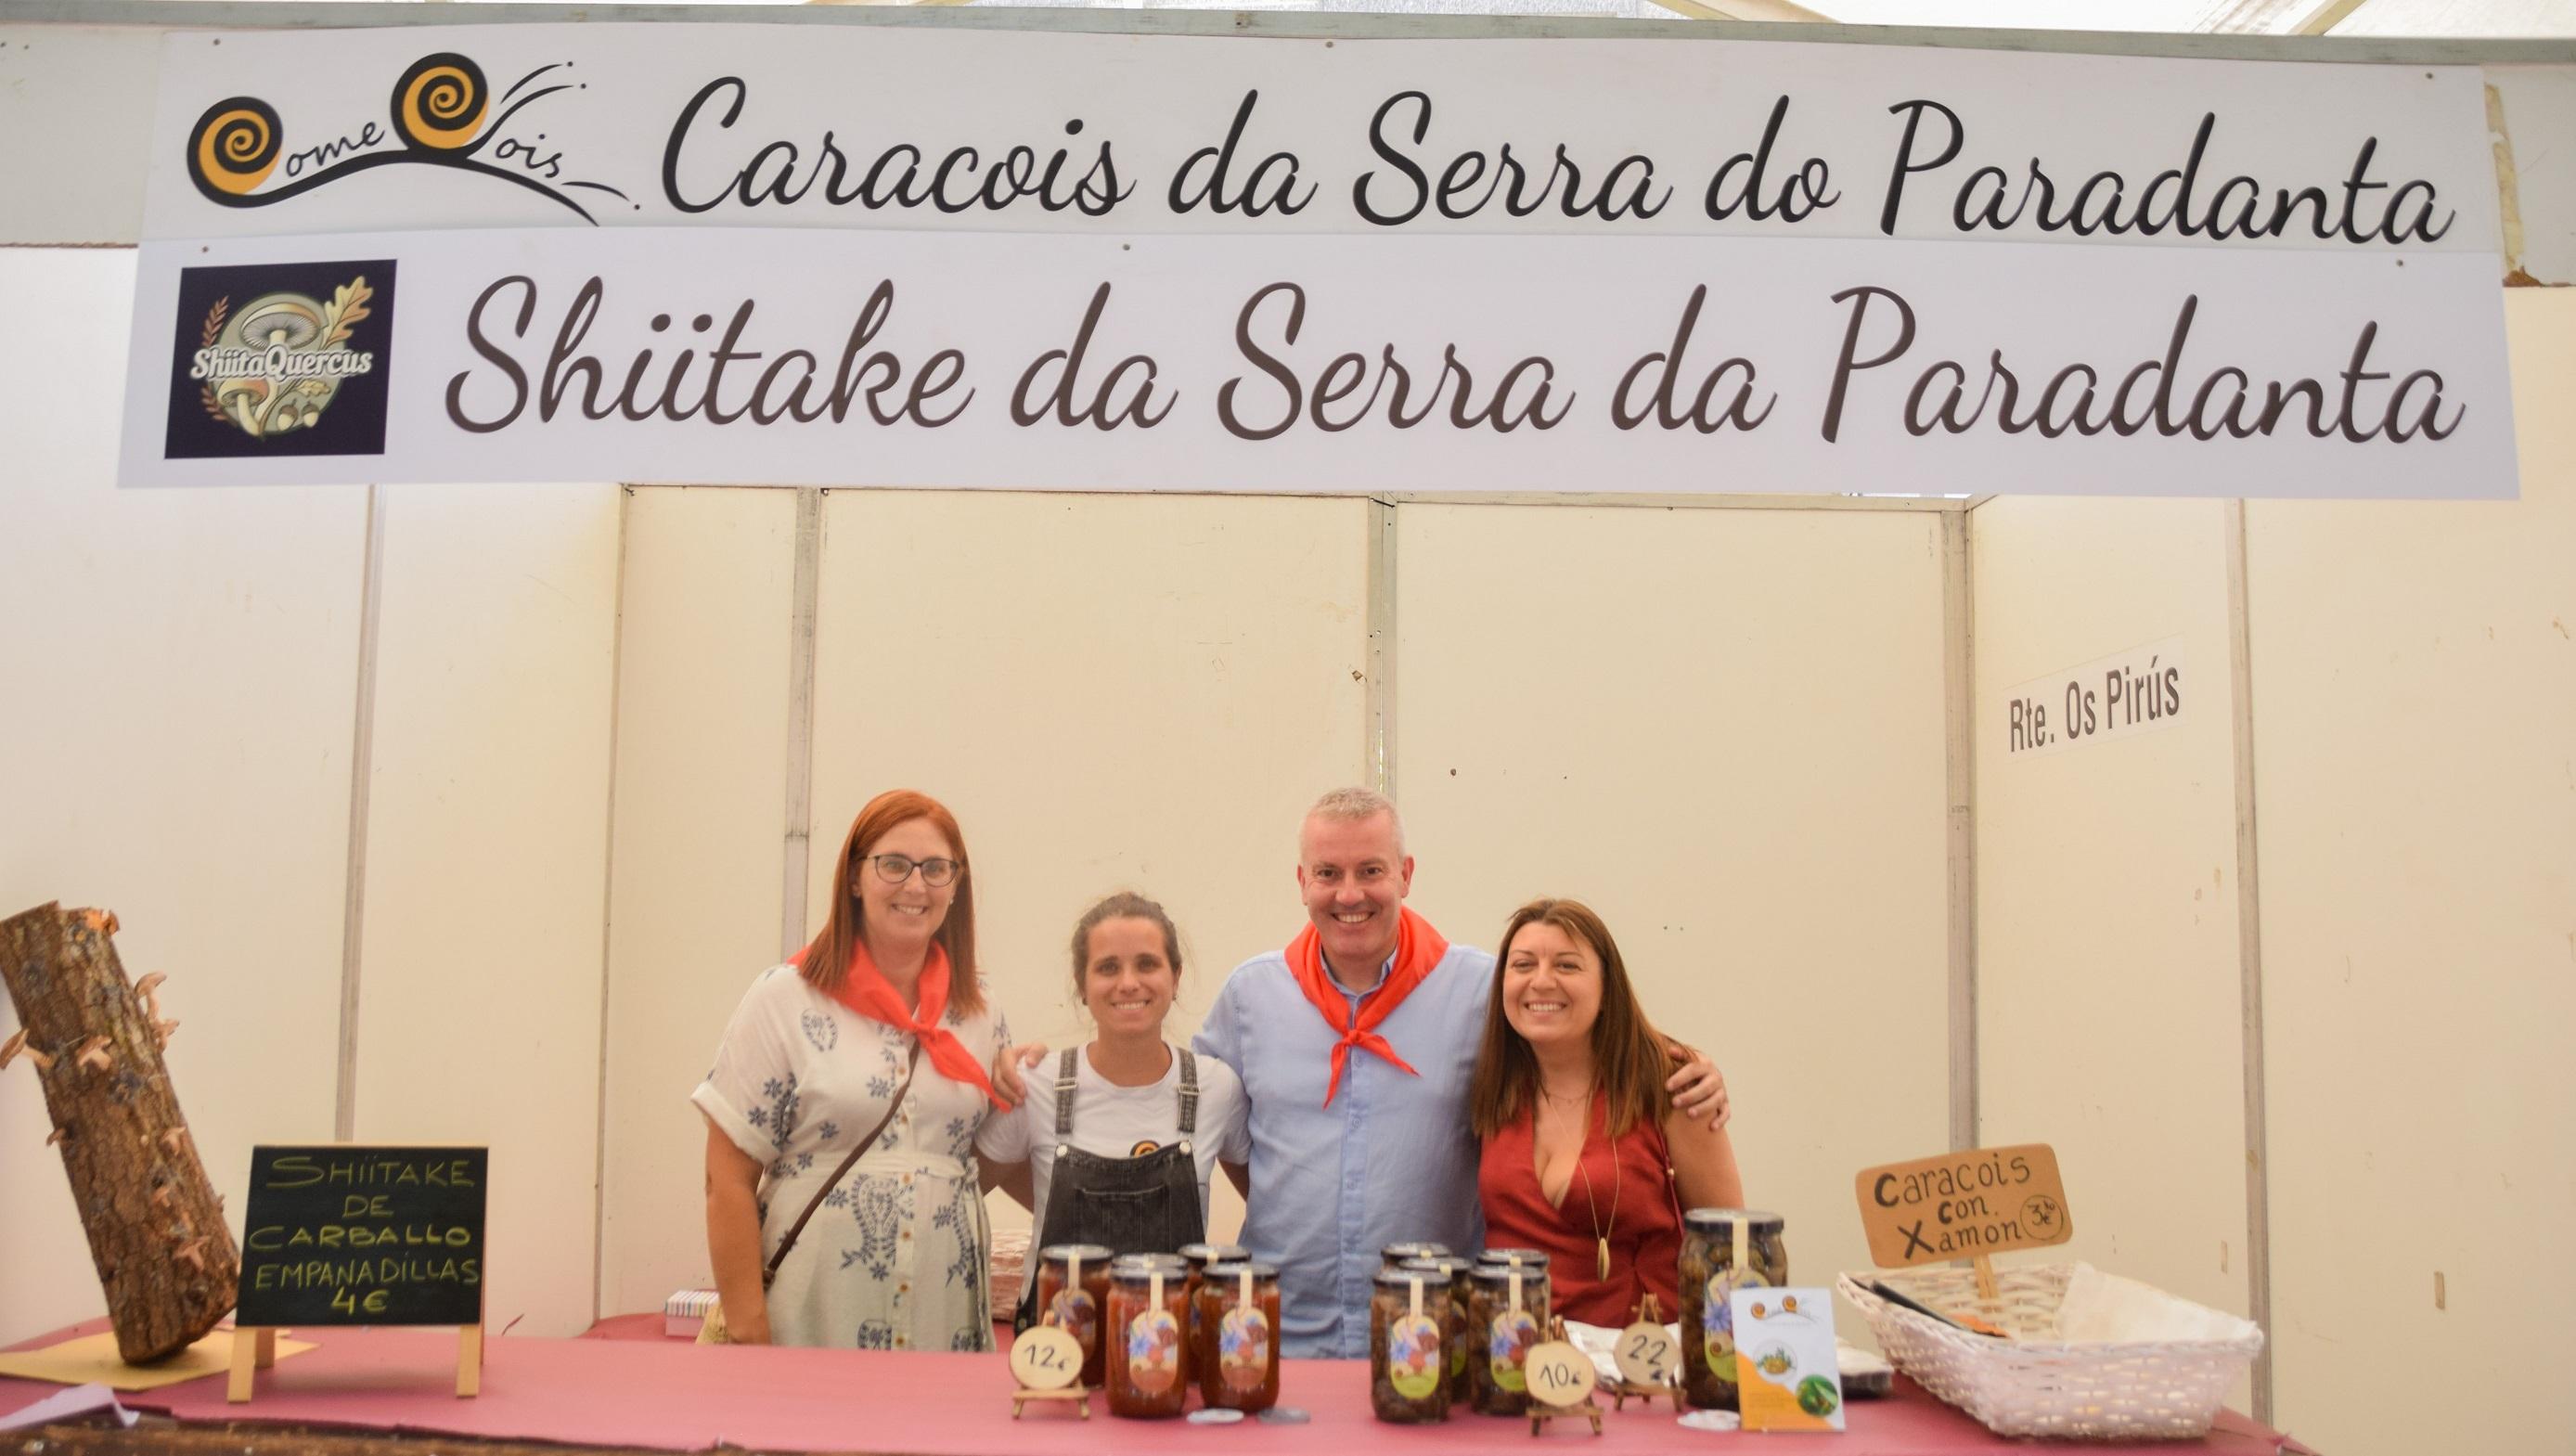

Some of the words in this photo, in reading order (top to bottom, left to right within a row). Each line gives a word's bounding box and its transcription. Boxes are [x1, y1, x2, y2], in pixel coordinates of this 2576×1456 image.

[663, 77, 1136, 216] Caracois
[1168, 89, 1318, 217] da
[1353, 91, 1673, 225] Serra
[1706, 96, 1841, 223] do
[1881, 100, 2455, 244] Paradanta
[191, 344, 373, 383] ShiitaQuercus
[445, 276, 975, 433] Shiitake
[1011, 282, 1179, 431] da
[1217, 282, 1576, 440] Serra
[1612, 284, 1777, 433] da
[1822, 287, 2466, 444] Paradanta
[2010, 698, 2054, 752] Rte.
[2066, 680, 2096, 739] Os
[2106, 655, 2180, 729] Pirús
[1874, 1153, 2030, 1207] Caracois
[342, 1195, 394, 1218] DE
[249, 1224, 471, 1249] CARBALLO
[1897, 1219, 2021, 1259] Xamon
